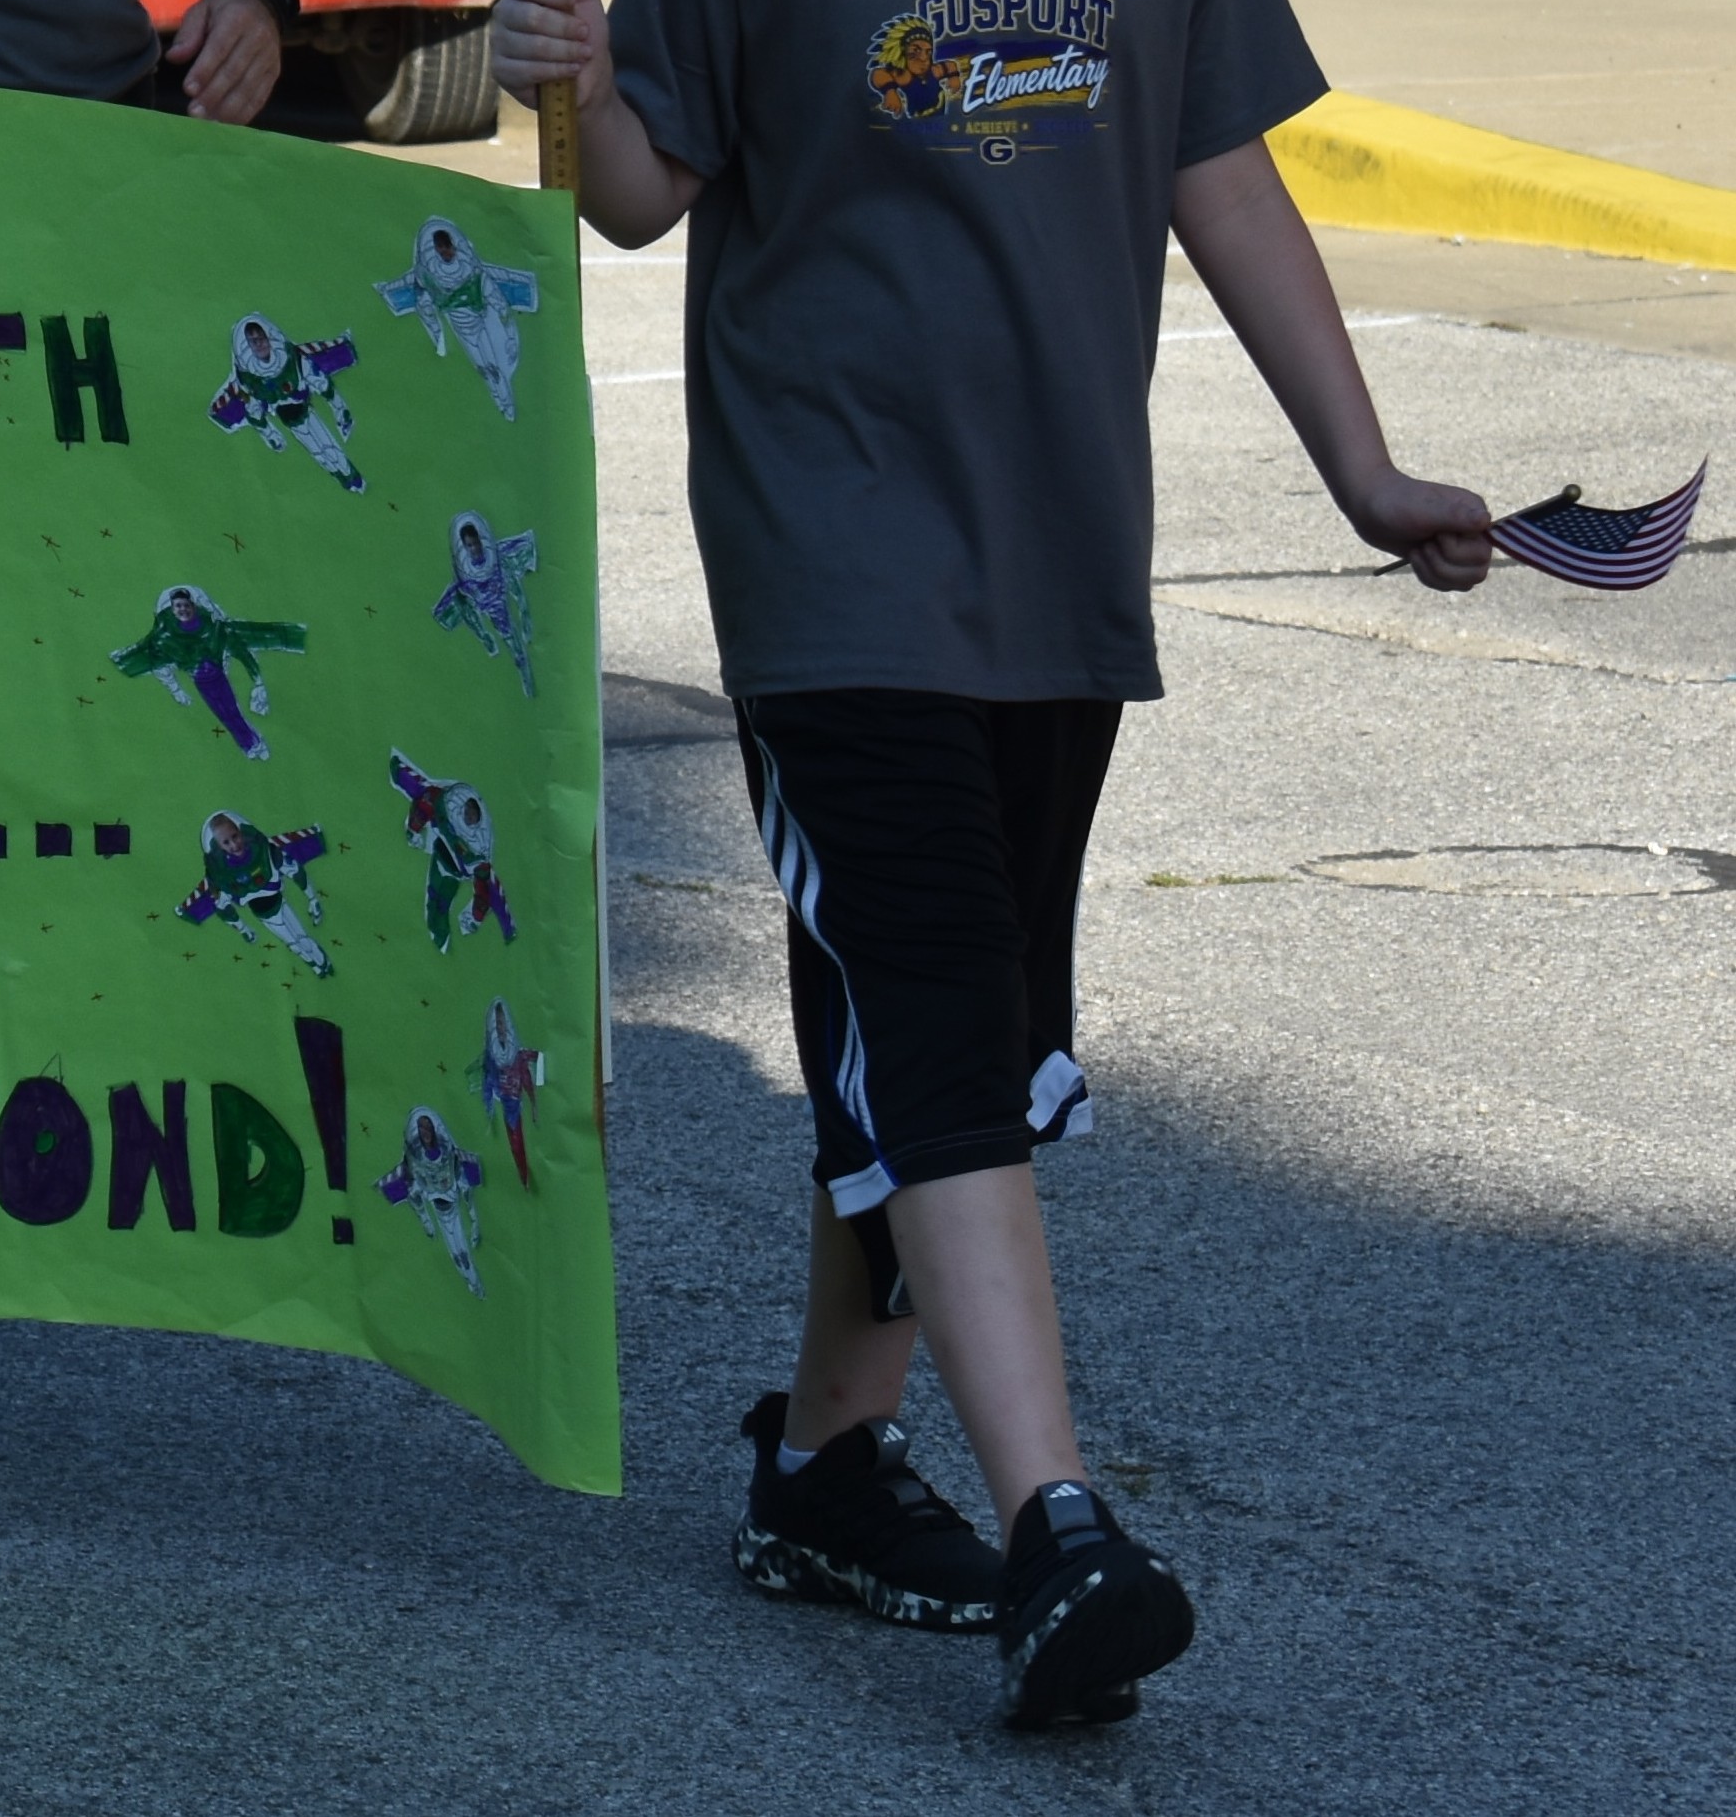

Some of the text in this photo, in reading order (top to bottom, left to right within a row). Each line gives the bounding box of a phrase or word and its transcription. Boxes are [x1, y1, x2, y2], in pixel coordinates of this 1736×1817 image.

[961, 44, 1108, 113] Elementary
[965, 121, 1018, 134] ACHIEVE
[980, 136, 1016, 164] G
